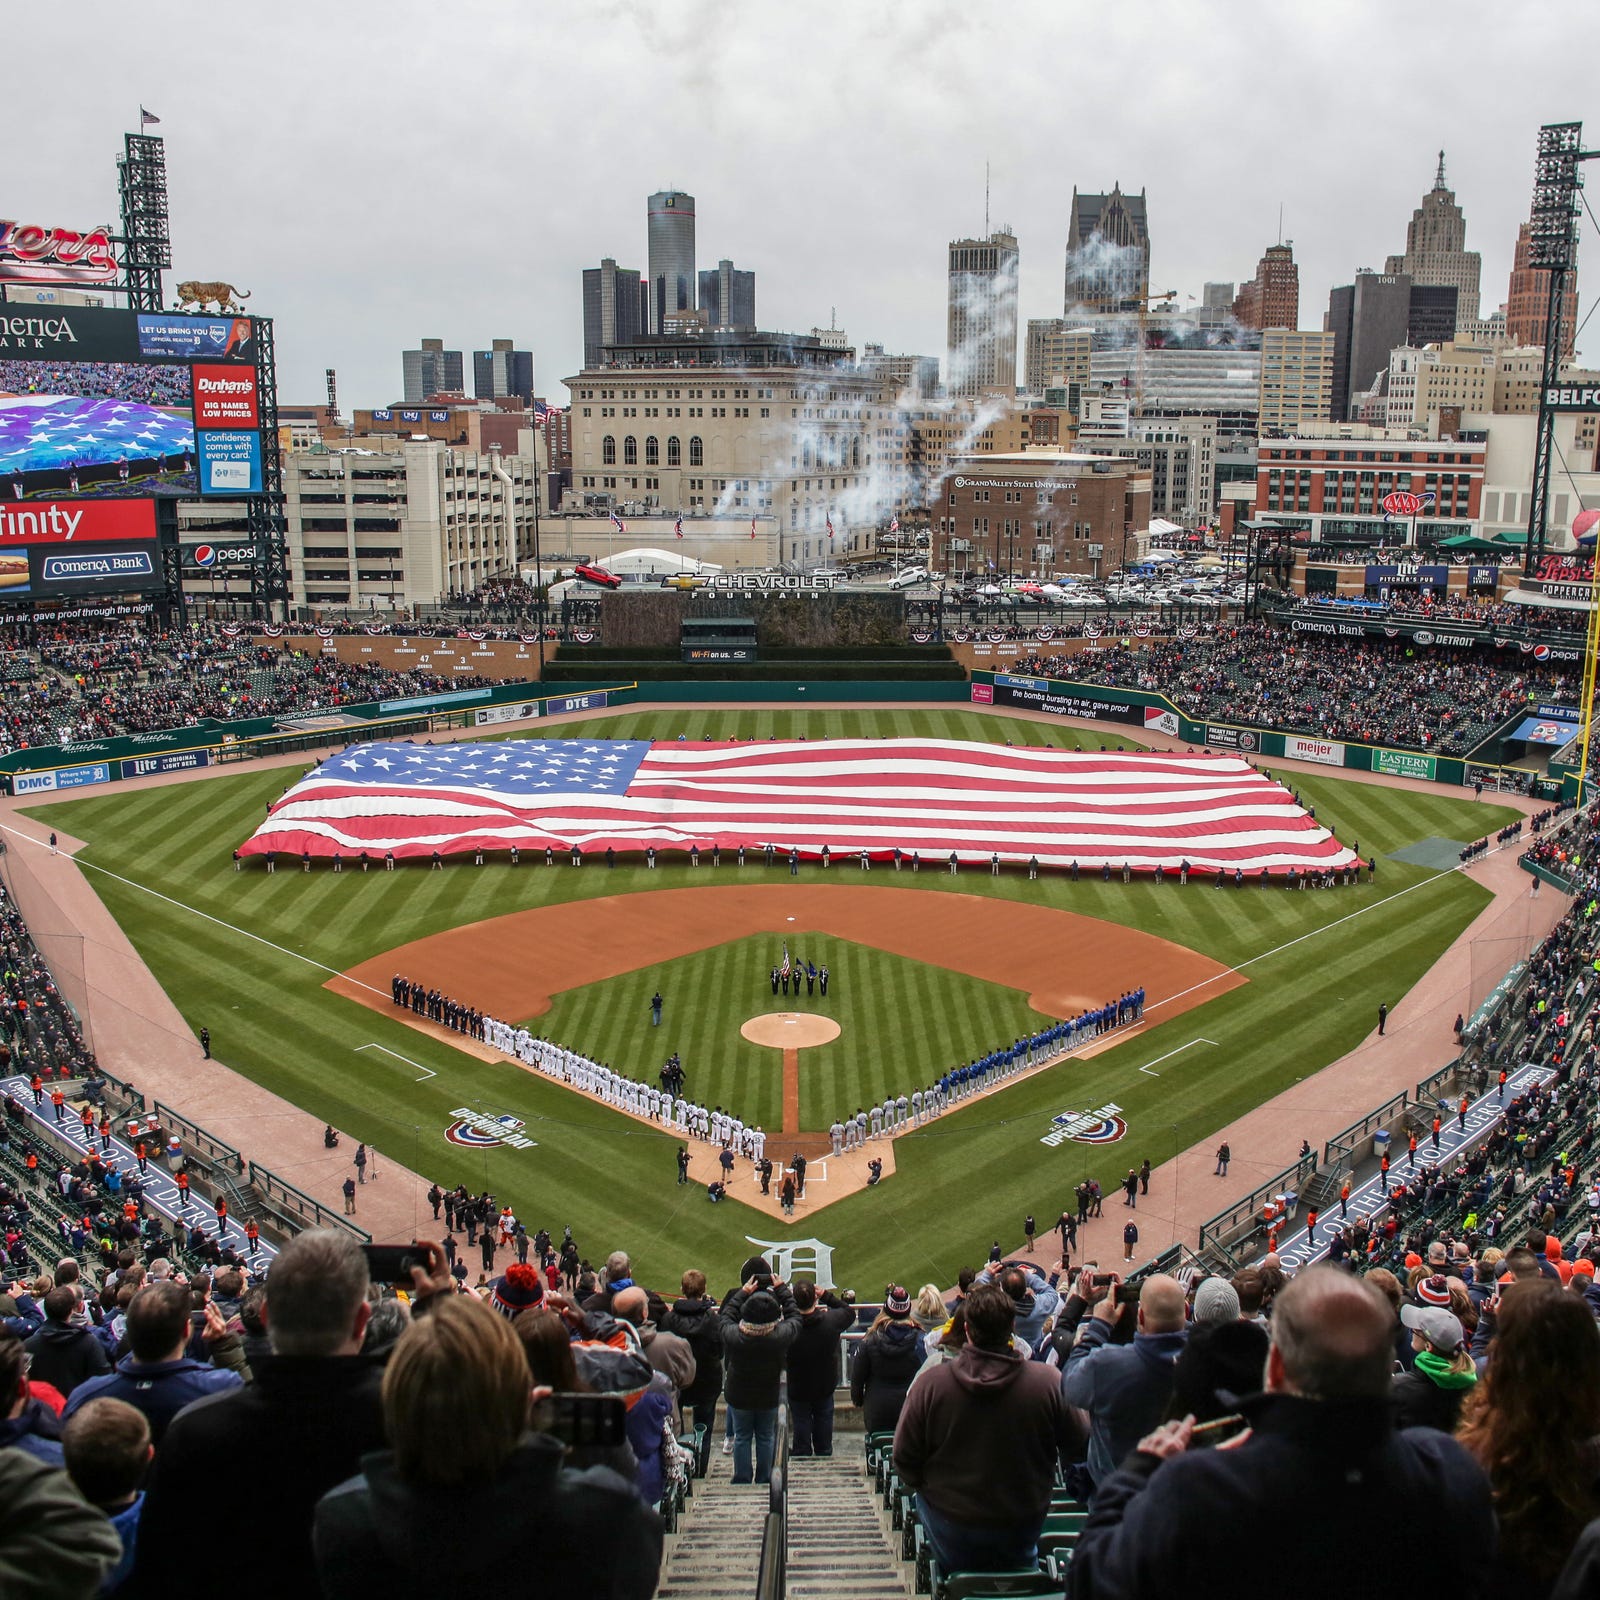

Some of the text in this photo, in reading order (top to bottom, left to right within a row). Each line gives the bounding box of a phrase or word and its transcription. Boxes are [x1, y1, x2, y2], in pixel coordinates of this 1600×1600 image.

[156, 327, 167, 335] US
[192, 328, 208, 336] YOU
[198, 378, 253, 392] Dunham's
[221, 402, 249, 410] NAMES
[205, 433, 251, 442] Confidence
[234, 442, 252, 450] with
[206, 452, 228, 461] every
[965, 479, 1077, 489] GRAND VALLEY STATE UNIVERSITY
[217, 546, 257, 562] pepsi
[112, 557, 143, 569] Bank
[1397, 562, 1419, 576] Lite
[714, 575, 838, 589] CHEVROLET
[5, 614, 14, 623] in
[16, 613, 31, 623] air,
[33, 611, 56, 622] gave
[57, 608, 82, 620] proof
[82, 606, 115, 617] through
[117, 606, 131, 614] the
[132, 603, 154, 613] night
[1338, 626, 1366, 637] Bank
[441, 640, 447, 649] 2
[1435, 634, 1475, 647] DETROIT
[691, 651, 710, 659] Wi-Fi
[720, 651, 731, 659] us.
[1550, 648, 1579, 661] pepsi
[565, 697, 589, 710] DTE
[1012, 690, 1023, 698] the
[1023, 691, 1045, 701] bombs
[1046, 695, 1072, 706] bursting
[1092, 701, 1109, 710] gave
[1110, 705, 1130, 713] proof
[1042, 703, 1097, 718] through the night
[1539, 707, 1565, 716] BELLE
[1297, 741, 1332, 756] meijer
[169, 754, 196, 762] ORIGINAL
[1379, 752, 1429, 769] EASTERN
[134, 760, 157, 774] Lite
[18, 777, 53, 790] DMC
[448, 1107, 539, 1149] OPENING DAY
[1040, 1102, 1123, 1147] OPENING DAY
[1386, 1136, 1456, 1187] DETROIT
[1446, 1101, 1503, 1139] TIGERS
[155, 1187, 240, 1243] DETROIT
